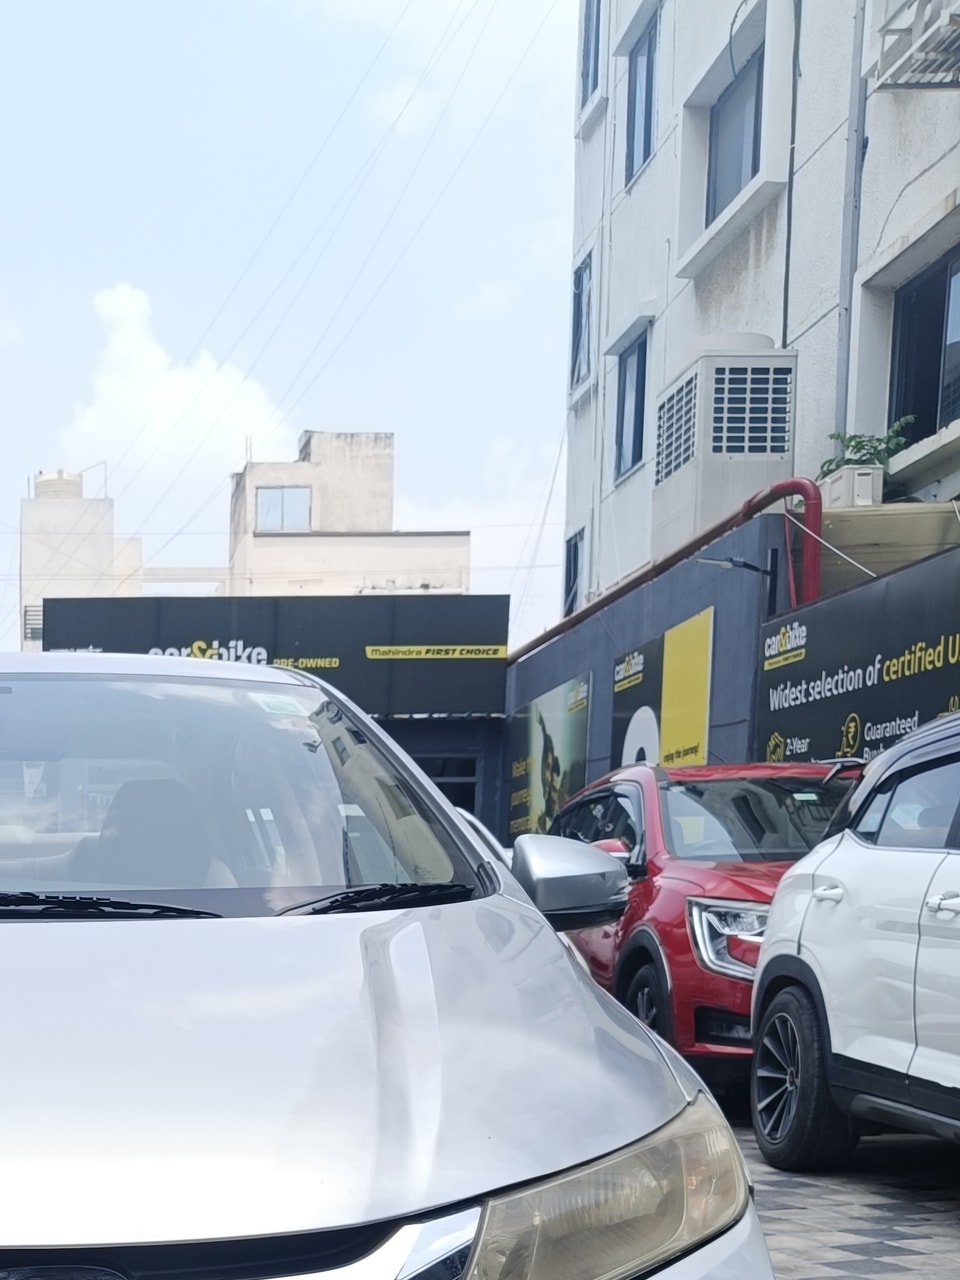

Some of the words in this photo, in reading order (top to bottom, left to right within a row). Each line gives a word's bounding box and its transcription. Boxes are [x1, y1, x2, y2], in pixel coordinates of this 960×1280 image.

[765, 620, 807, 657] car&bike
[273, 658, 339, 668] PRE-OWNED
[371, 648, 422, 656] Mahindra
[424, 648, 457, 656] FIRST
[769, 680, 808, 711] Widest
[809, 665, 863, 702] selection
[866, 654, 882, 686] of
[883, 635, 944, 682] certified
[948, 633, 960, 665] U
[864, 710, 919, 741] Guaranteed
[785, 737, 810, 755] 2-Year
